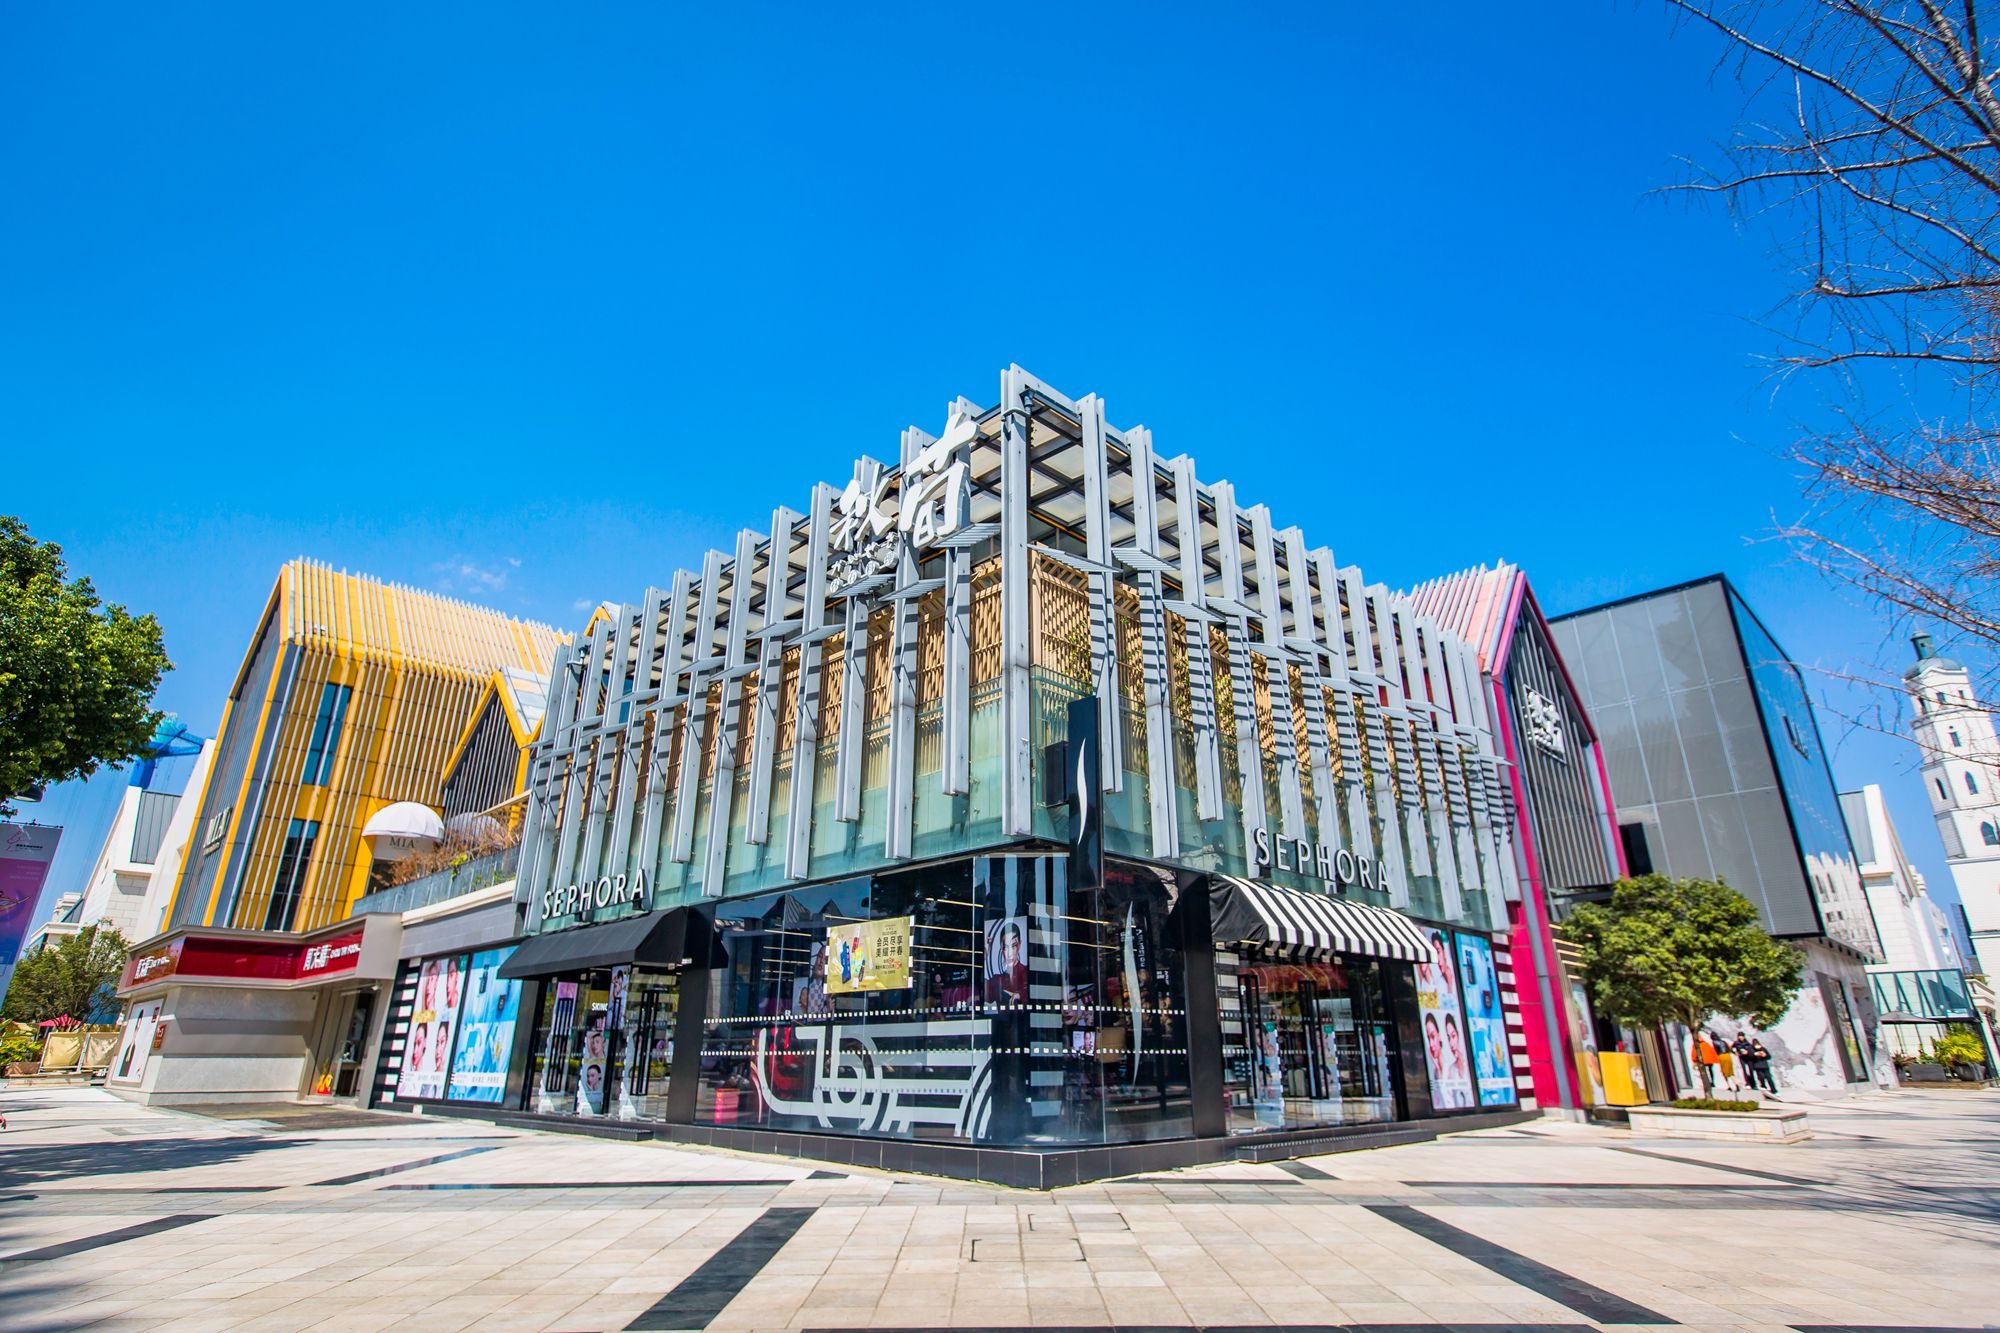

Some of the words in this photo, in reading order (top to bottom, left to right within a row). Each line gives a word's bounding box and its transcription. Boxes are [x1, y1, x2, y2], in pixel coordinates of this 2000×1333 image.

[389, 836, 415, 849] MIA
[1253, 827, 1391, 893] SEPHORA
[541, 868, 645, 920] SEPHORA
